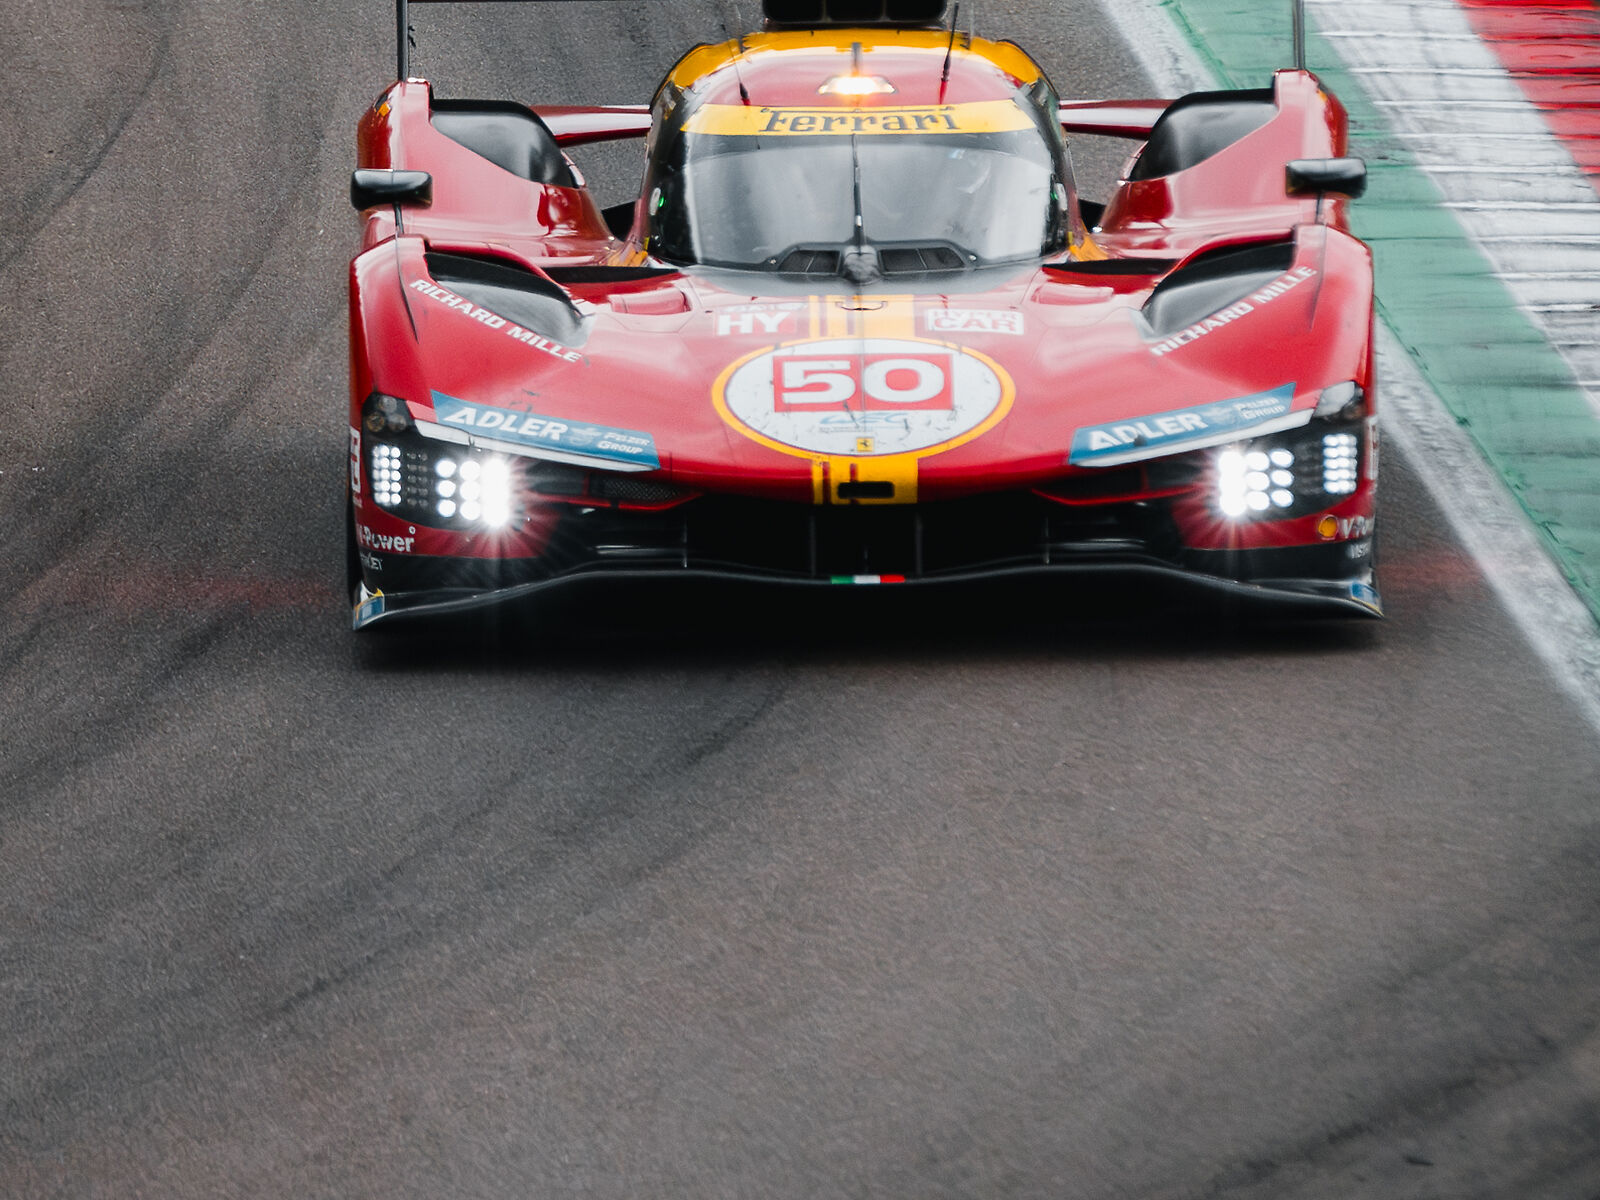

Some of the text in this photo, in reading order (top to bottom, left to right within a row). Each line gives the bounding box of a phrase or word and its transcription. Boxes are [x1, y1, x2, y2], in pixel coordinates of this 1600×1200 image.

[758, 107, 961, 132] Ferrari
[409, 279, 582, 363] RICHARD MILLE
[717, 311, 791, 336] HY
[934, 317, 1016, 331] CAR
[1151, 266, 1317, 356] RICHARD MILLE
[781, 358, 945, 404] 50
[443, 406, 568, 440] ADLER
[1089, 412, 1208, 451] ADLER
